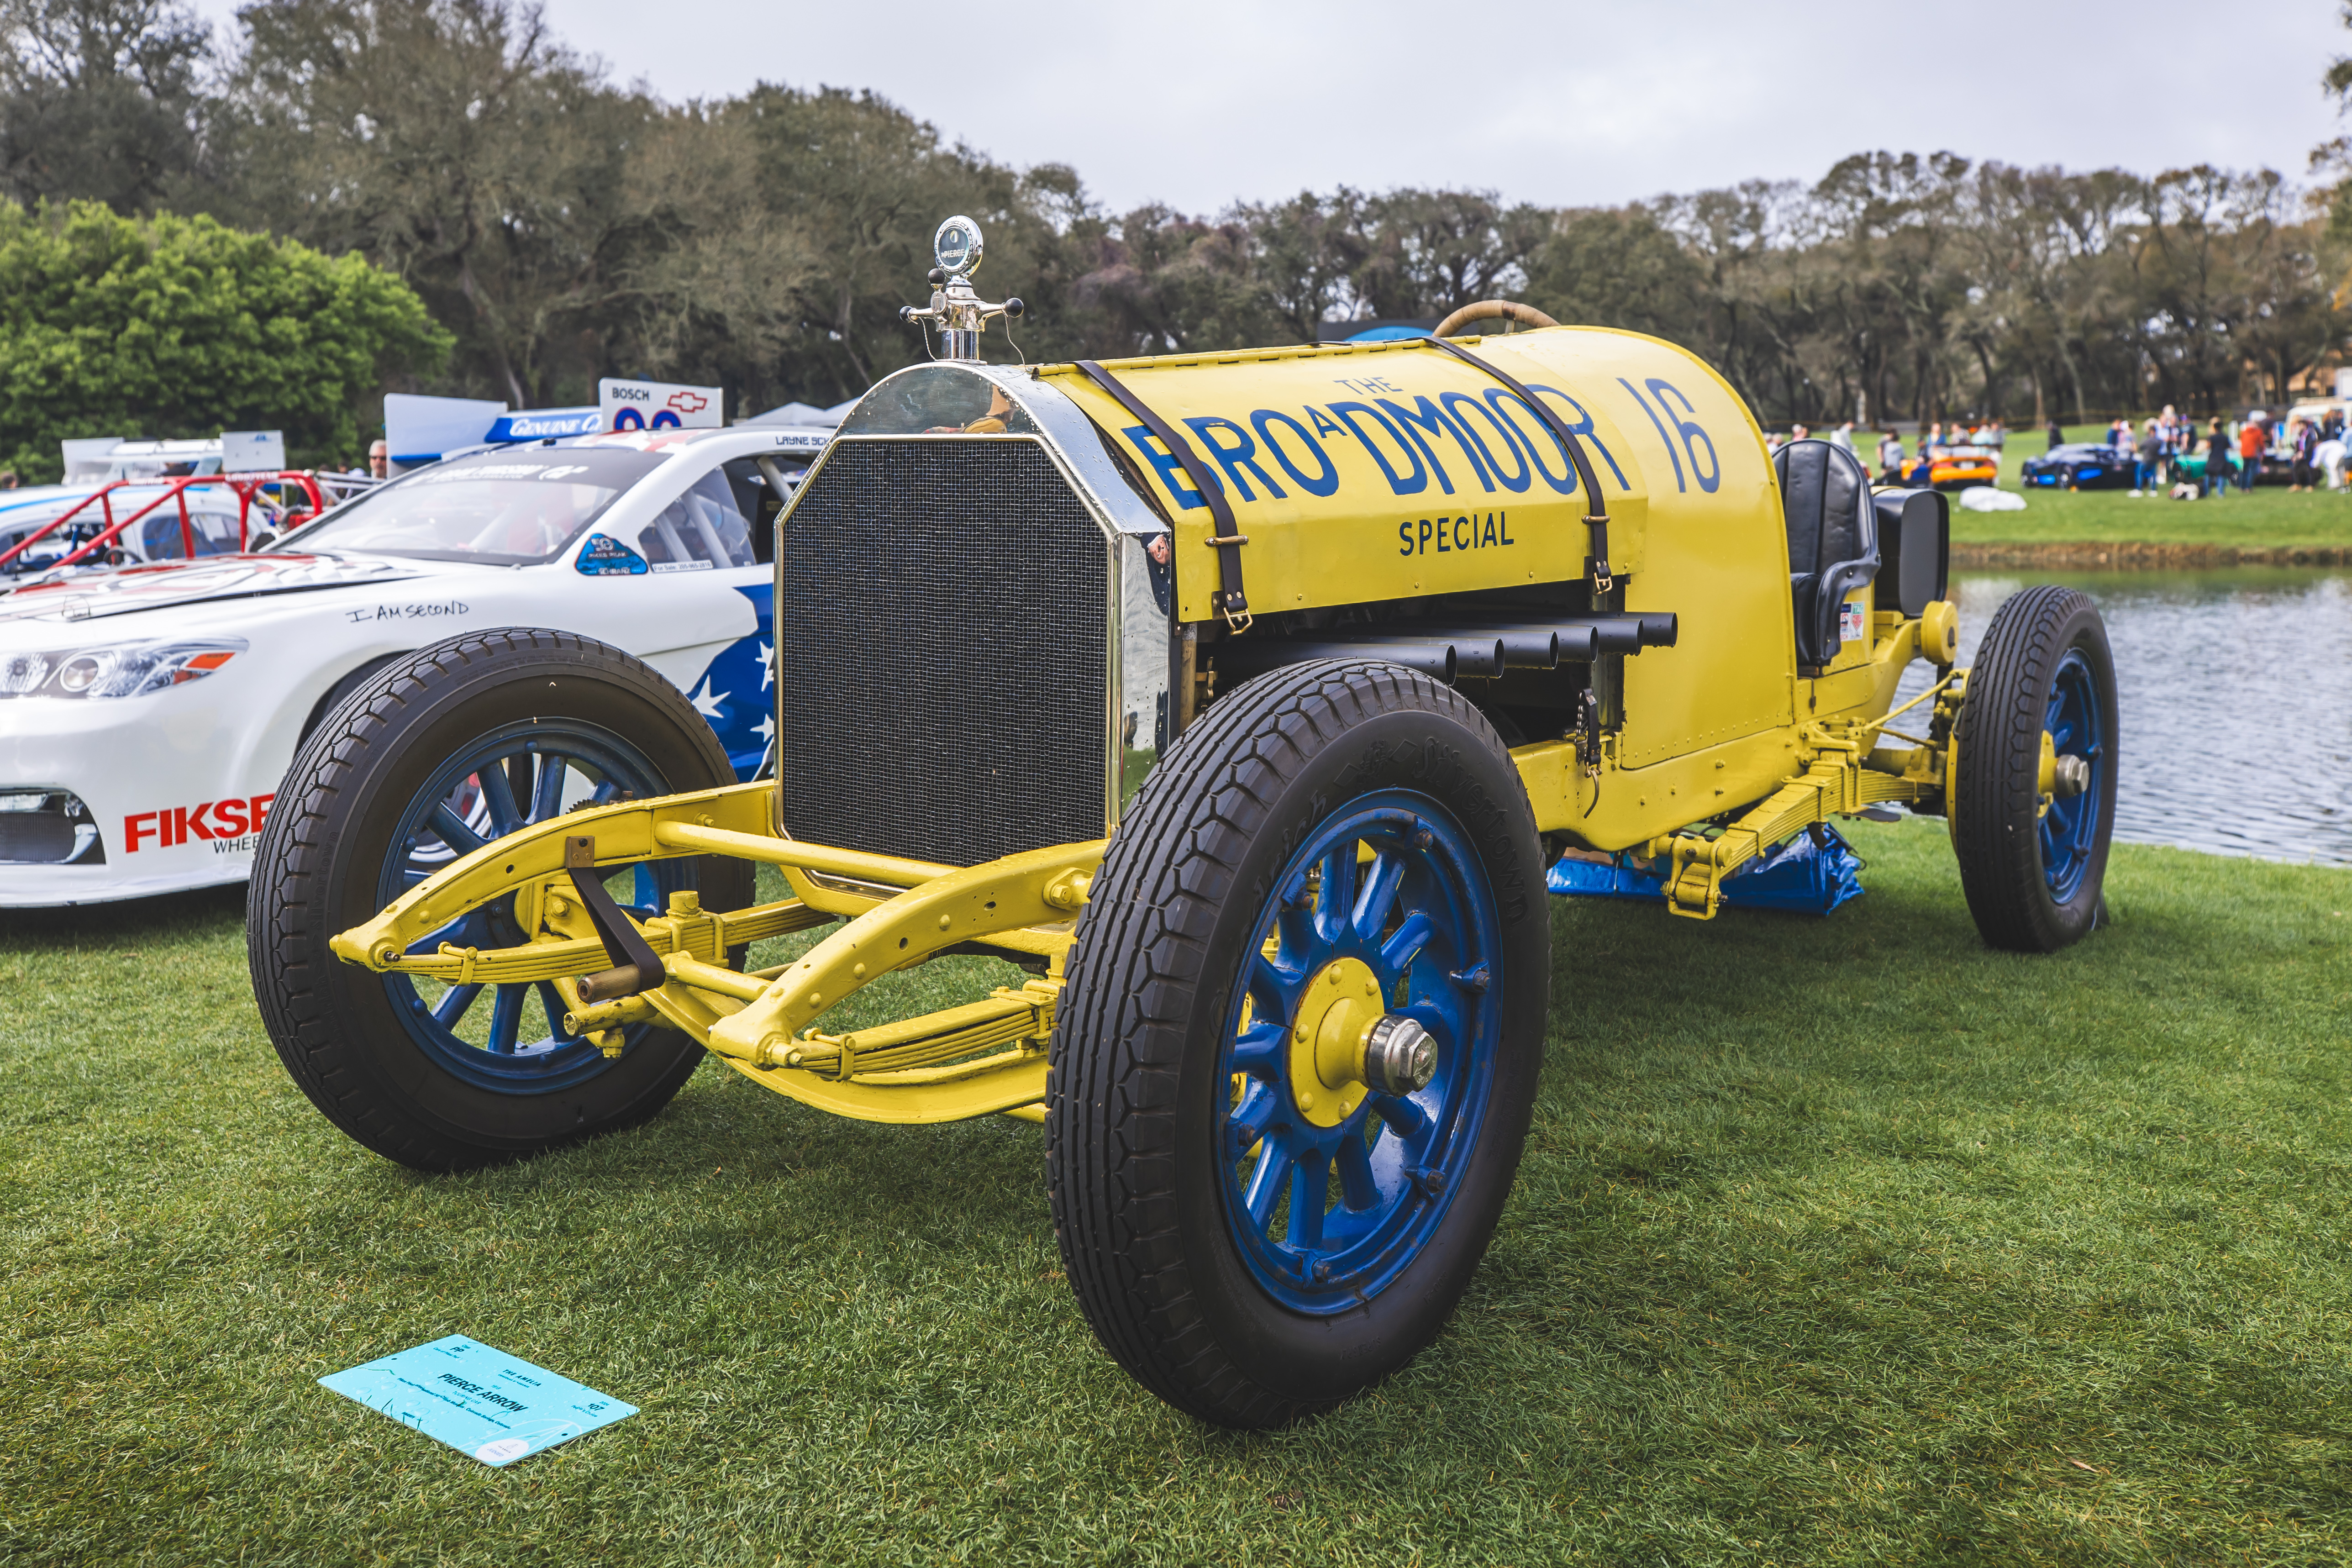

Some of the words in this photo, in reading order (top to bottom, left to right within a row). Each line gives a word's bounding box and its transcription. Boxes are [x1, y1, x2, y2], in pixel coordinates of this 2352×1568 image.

[944, 249, 964, 258] PIERCE
[612, 387, 649, 401] BOSCH
[1333, 376, 1404, 395] THE
[510, 417, 581, 437] GENUINE
[776, 436, 809, 445] LAYNE
[1120, 384, 1631, 510] BROADMOOR
[1616, 378, 1721, 493] 16
[1399, 511, 1514, 556] SPECIAL
[345, 610, 373, 622] I
[377, 605, 402, 620] AM
[405, 600, 469, 618] SECOND
[1414, 736, 1529, 927] Silvertown
[515, 1375, 542, 1387] AMELIA
[437, 1373, 484, 1394] PIERCE
[476, 1391, 528, 1412] ARROW
[452, 1391, 473, 1401] TOURING
